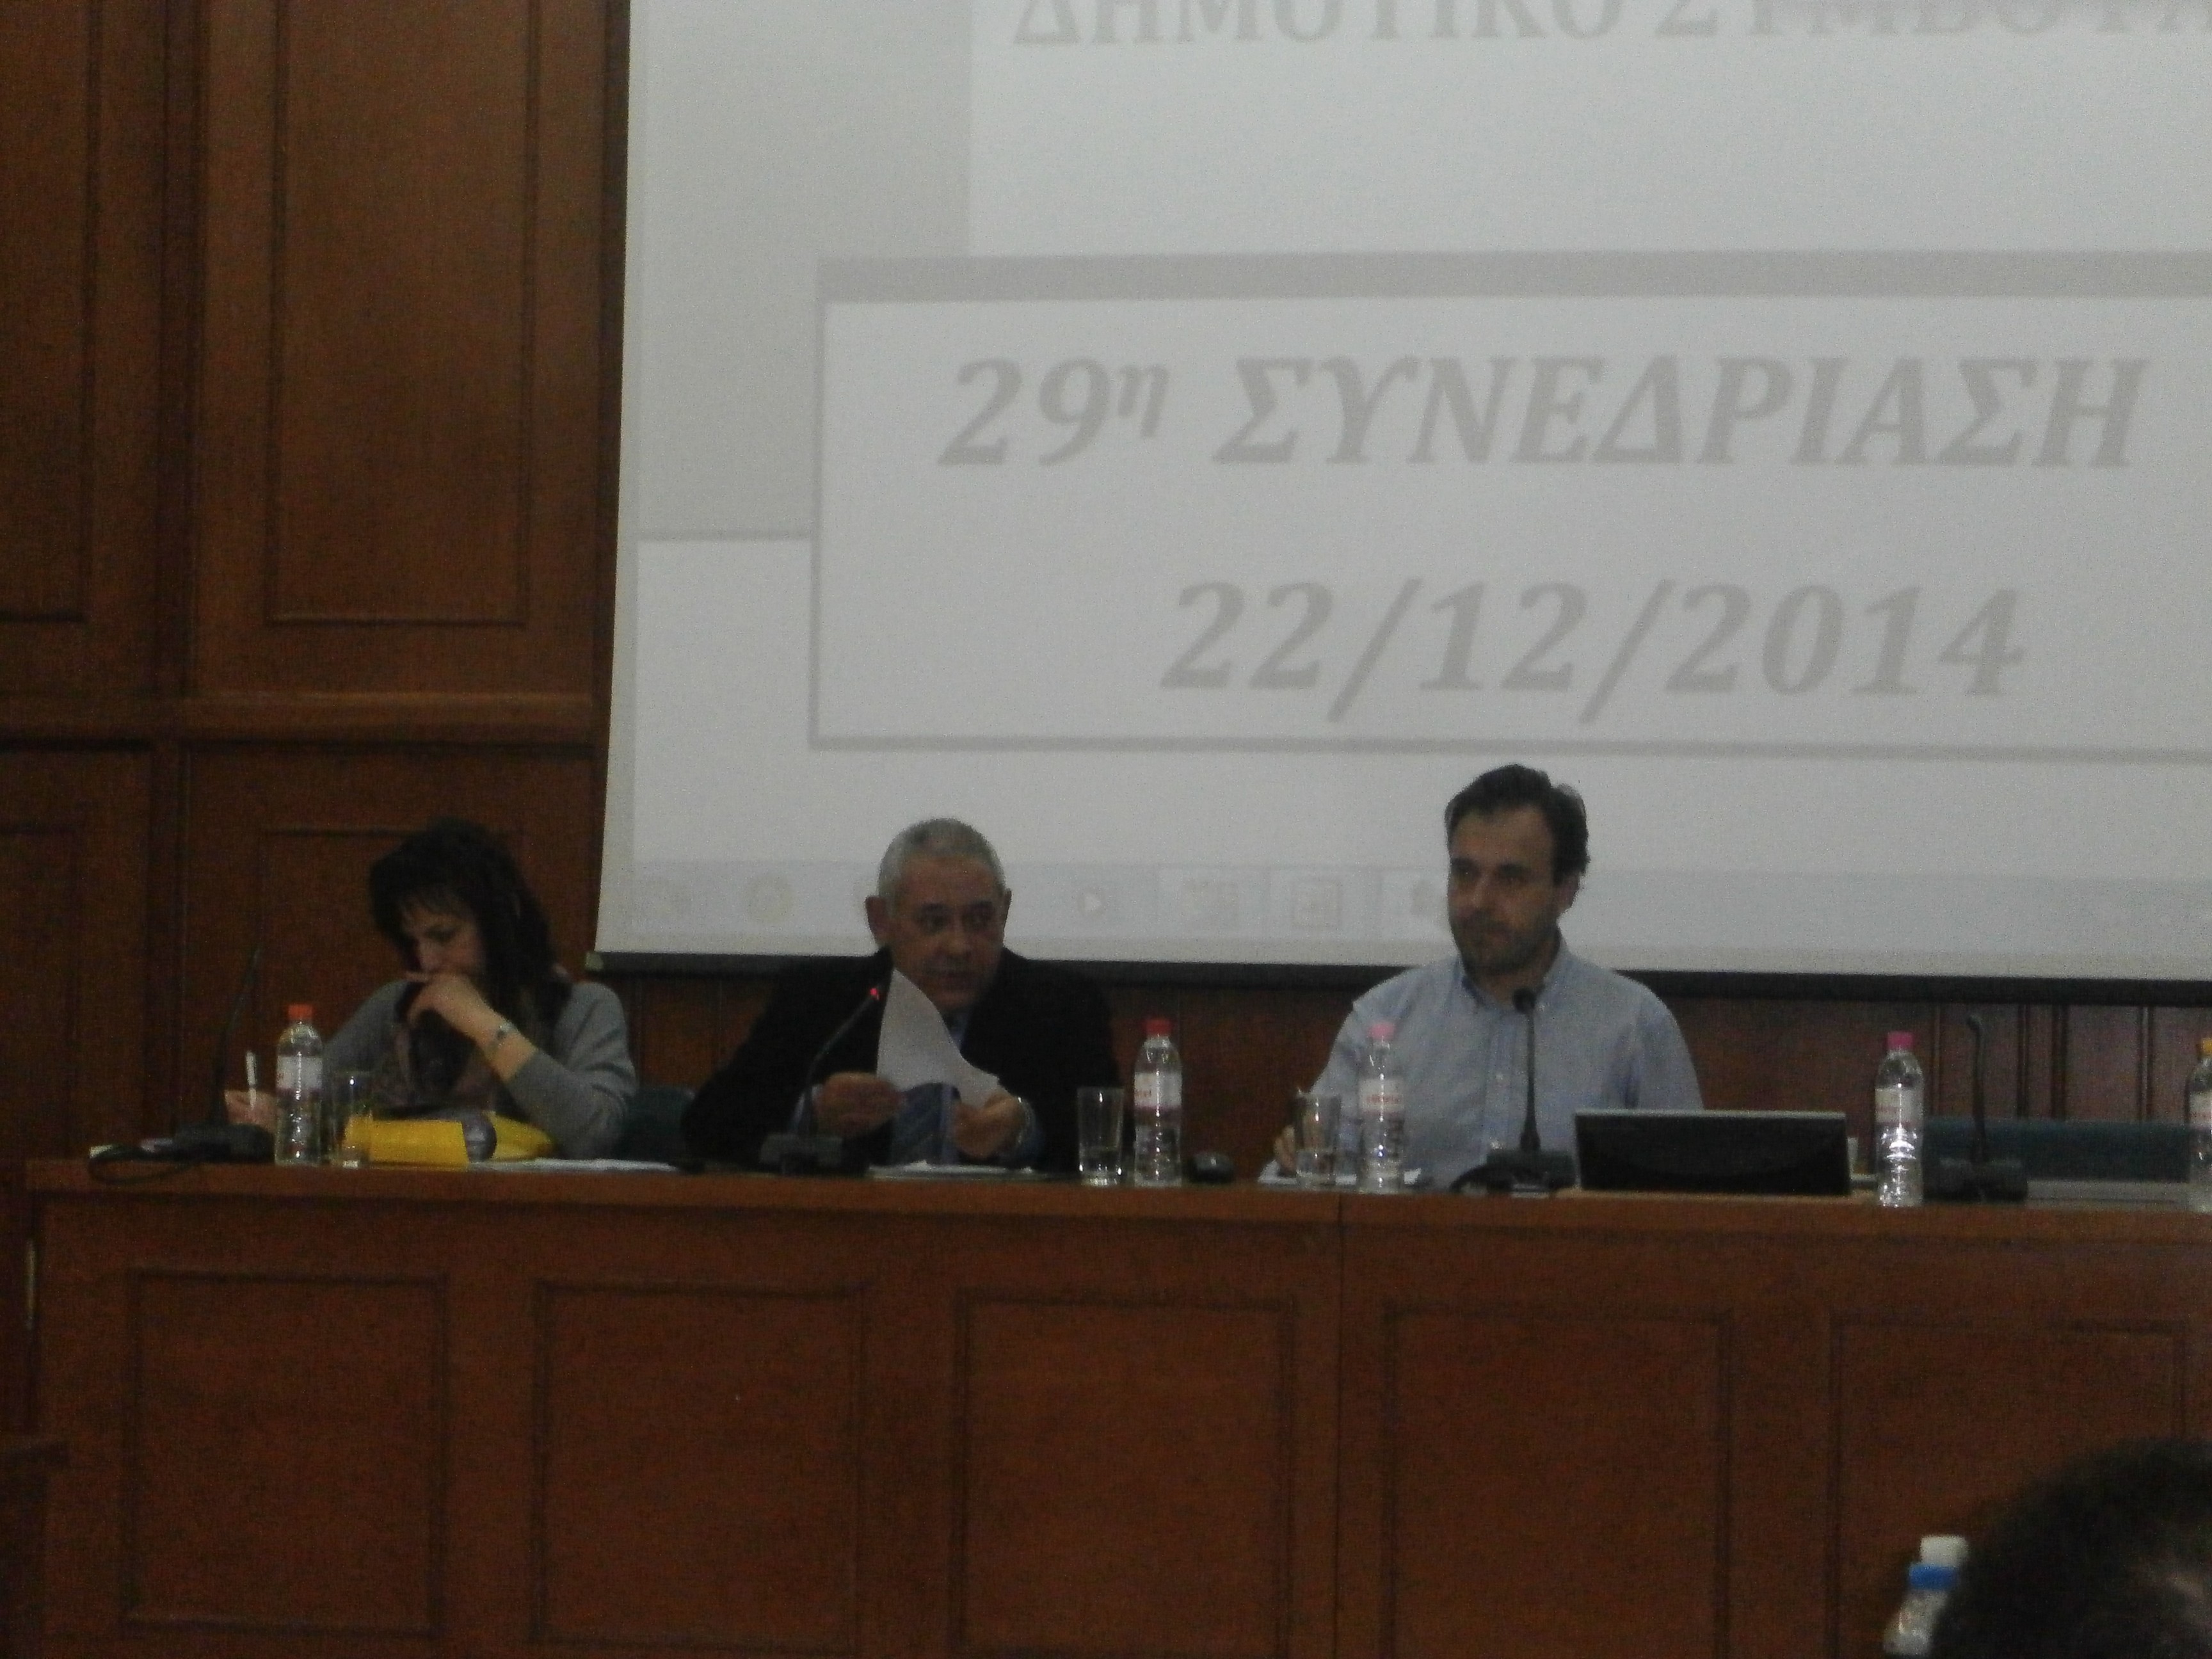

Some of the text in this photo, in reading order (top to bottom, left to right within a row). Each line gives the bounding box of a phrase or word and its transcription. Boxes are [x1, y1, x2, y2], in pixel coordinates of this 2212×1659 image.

[938, 356, 2147, 467] 29η ΣΥΝΕΔΡΙΑΣΗ
[1160, 579, 2024, 723] 22/12/2014
